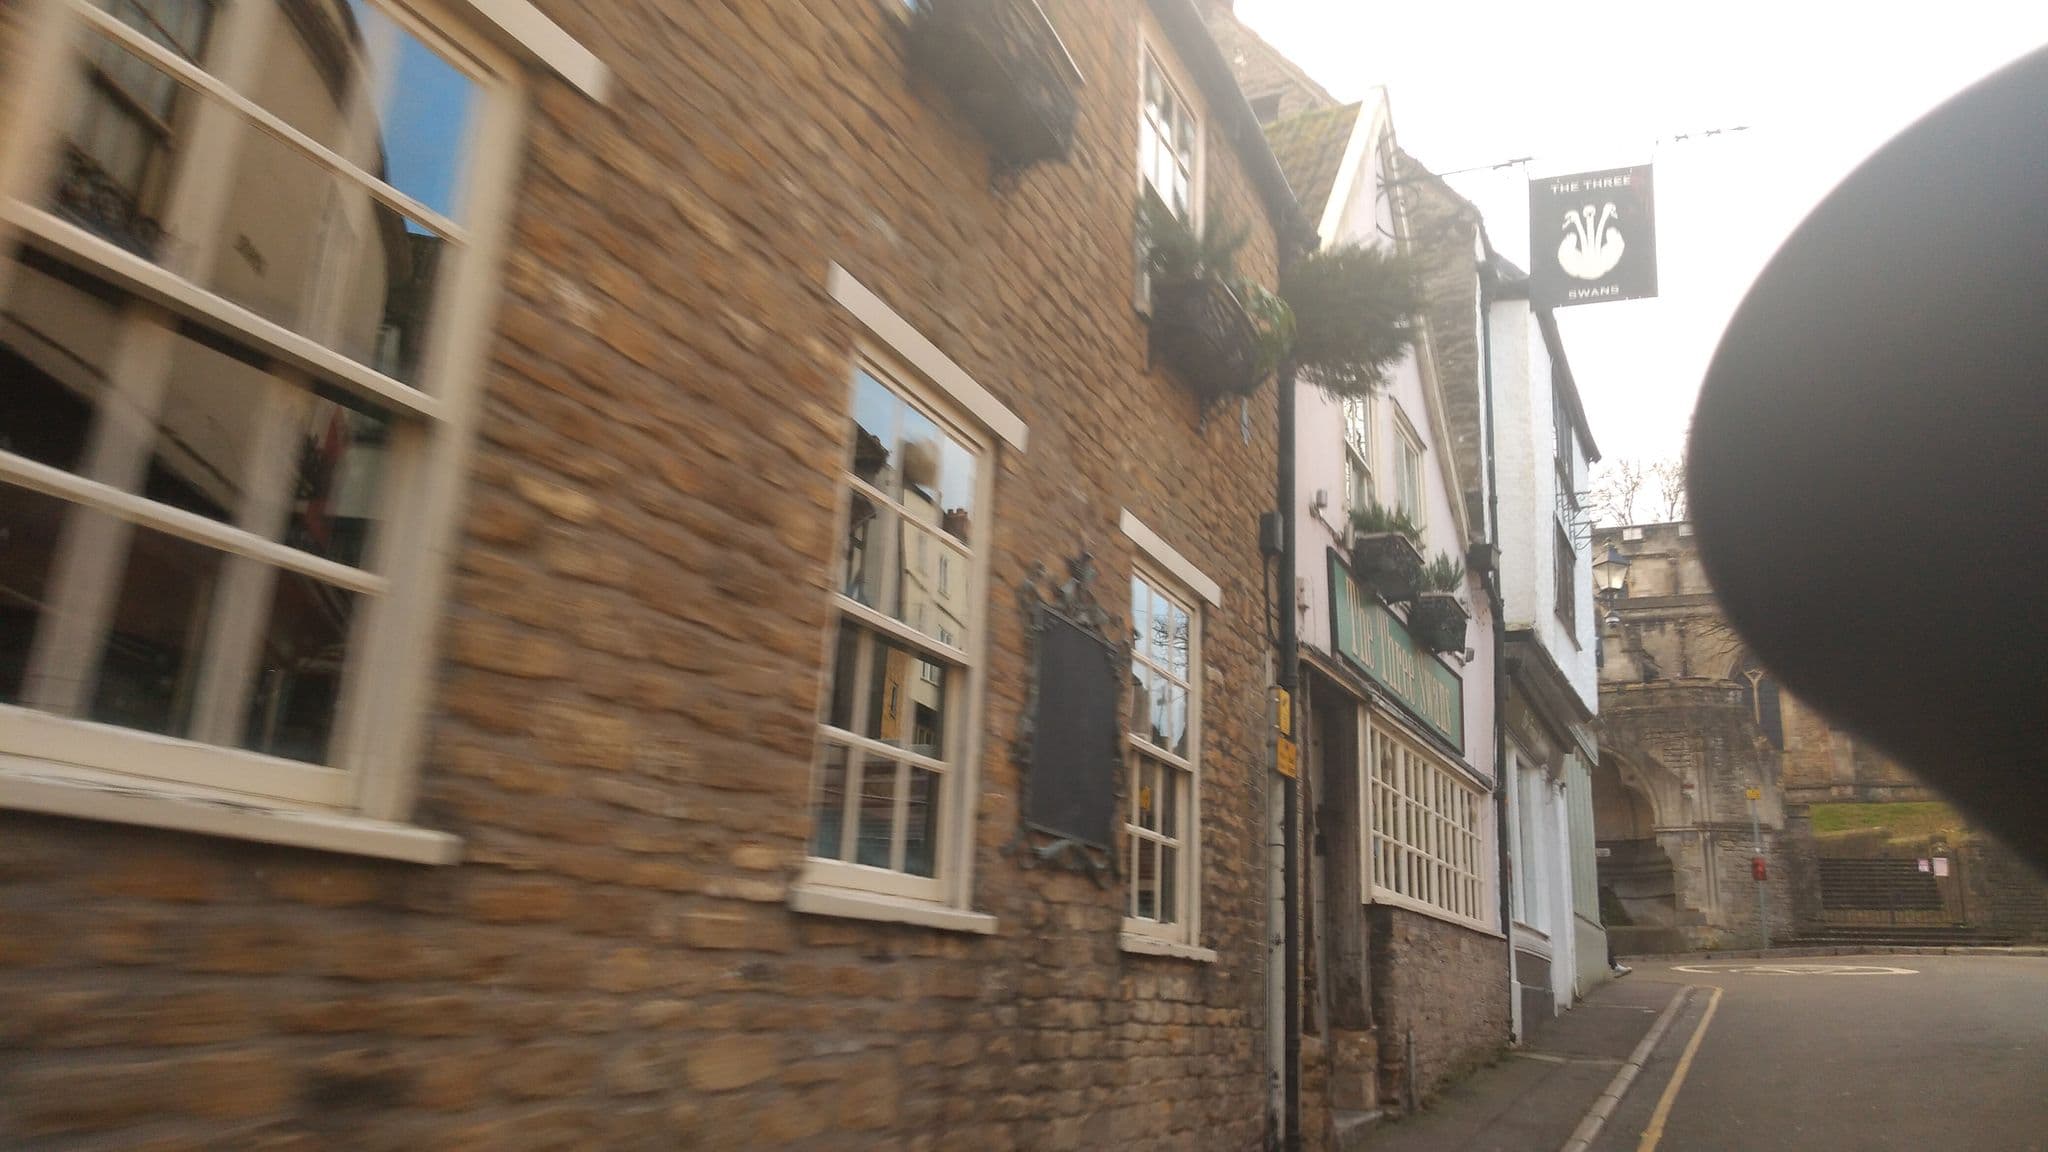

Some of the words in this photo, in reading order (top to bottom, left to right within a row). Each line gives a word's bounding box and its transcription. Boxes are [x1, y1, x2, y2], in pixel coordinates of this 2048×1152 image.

[1551, 183, 1580, 195] THE
[1583, 175, 1632, 190] THREE
[1568, 285, 1620, 299] SWANS
[1345, 576, 1375, 670] The
[1376, 605, 1416, 707] Three
[1416, 650, 1451, 736] Swans
